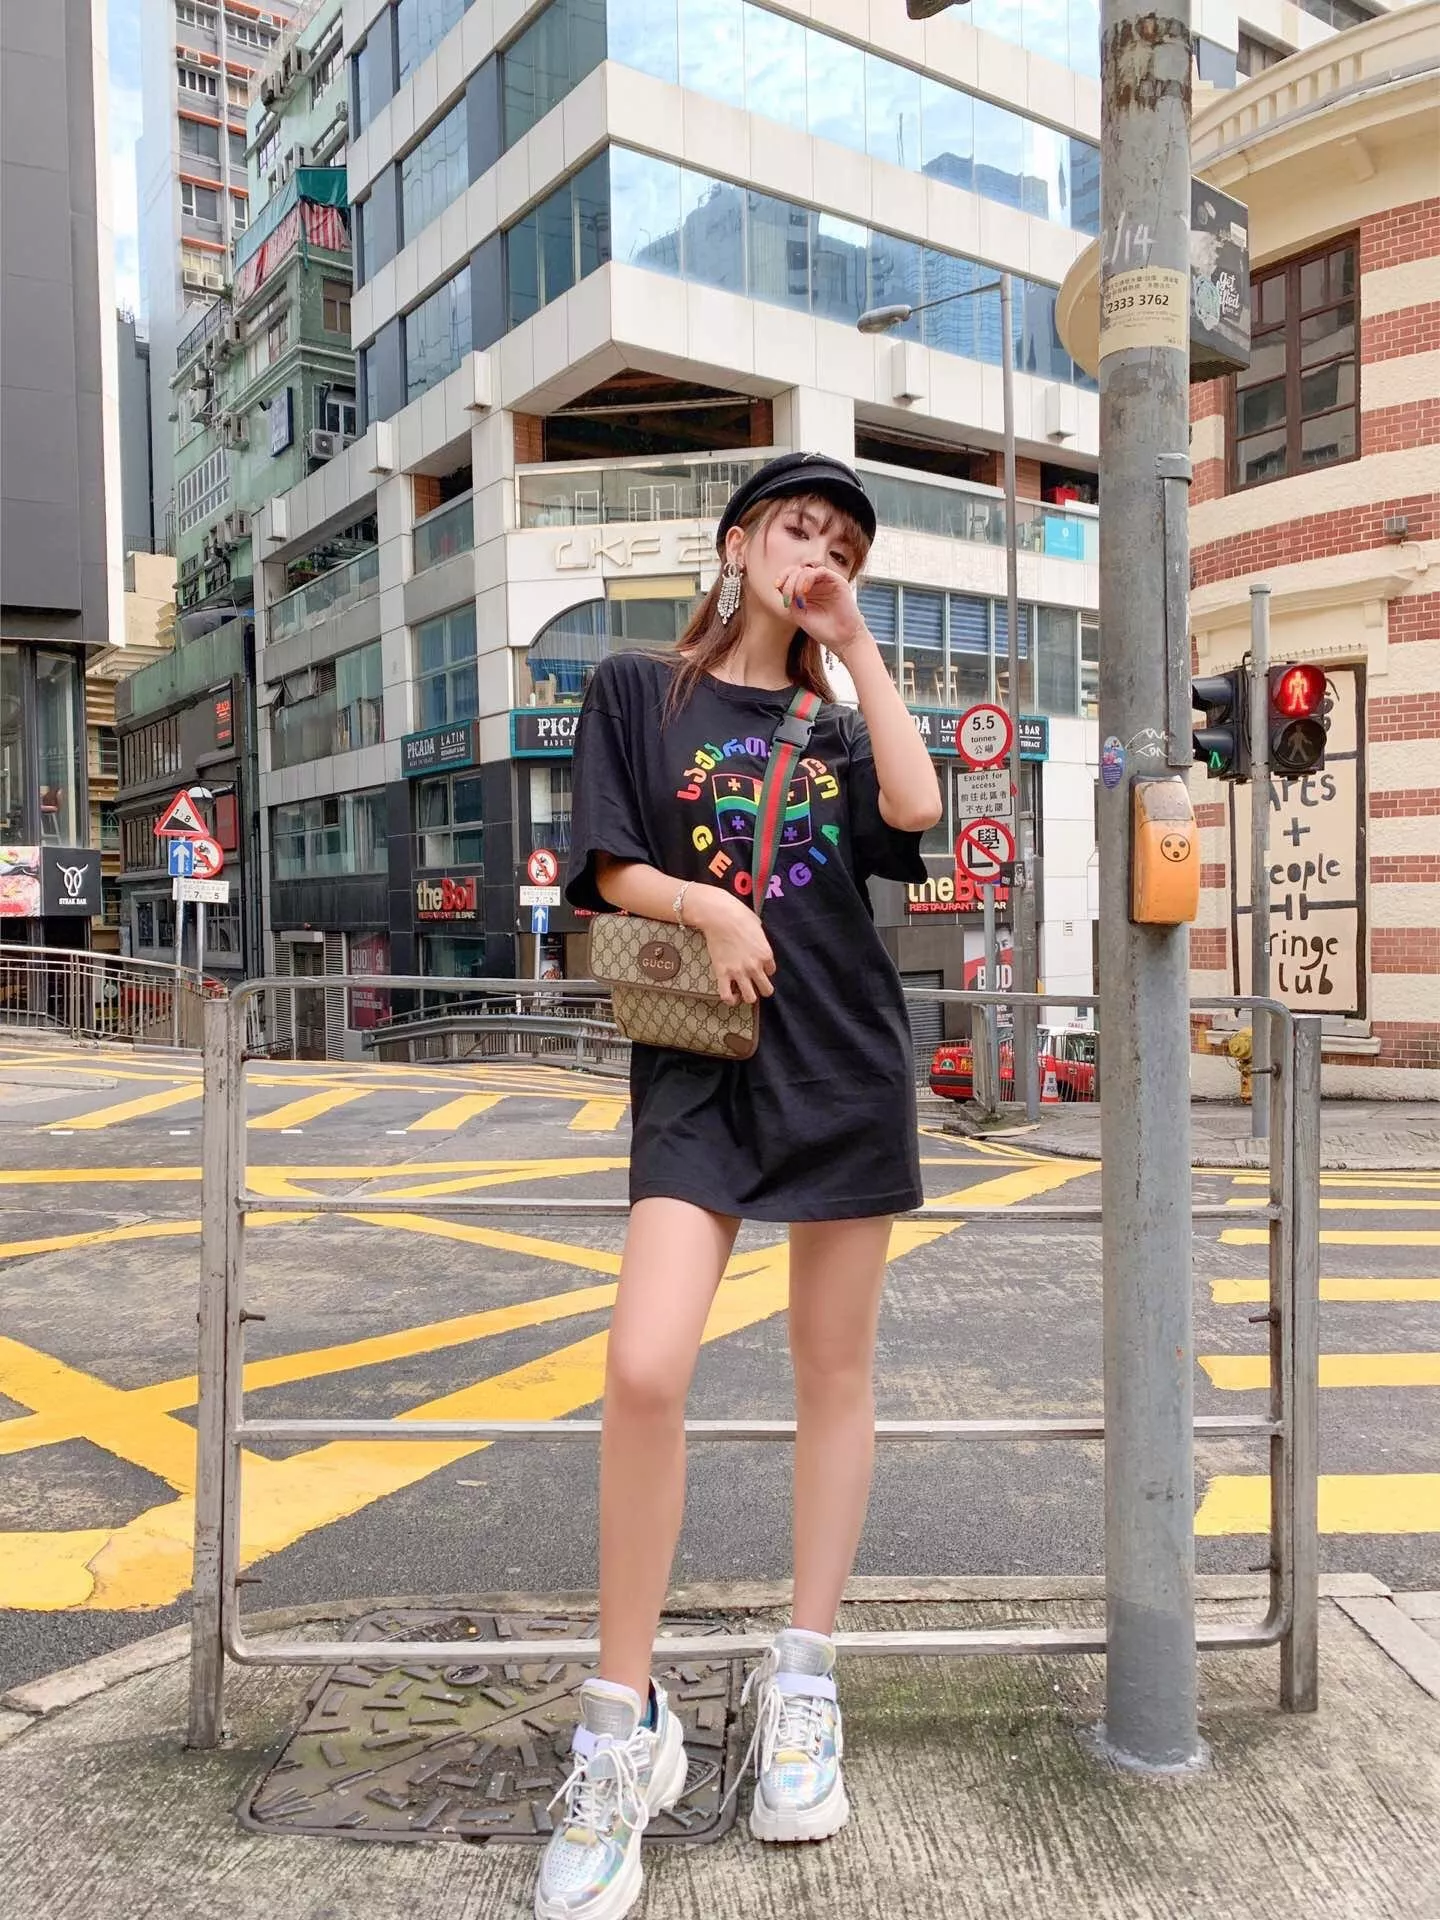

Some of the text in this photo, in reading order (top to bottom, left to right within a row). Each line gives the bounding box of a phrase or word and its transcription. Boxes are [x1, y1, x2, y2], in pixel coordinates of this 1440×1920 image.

[1107, 294, 1169, 314] 2333 3762
[677, 535, 720, 563] 2
[972, 715, 995, 731] 5.5
[1024, 724, 1040, 736] BAR
[407, 737, 435, 759] PICADA
[440, 730, 465, 746] LATIN
[971, 735, 997, 744] tonnes
[963, 772, 1003, 782] Except for
[972, 782, 996, 790] access
[692, 824, 841, 899] GEORGIA
[1270, 852, 1341, 890] eople
[909, 902, 975, 912] RESTAURANT
[1269, 930, 1339, 970] ringe
[642, 958, 674, 970] GUCCI
[1278, 963, 1334, 996] lub
